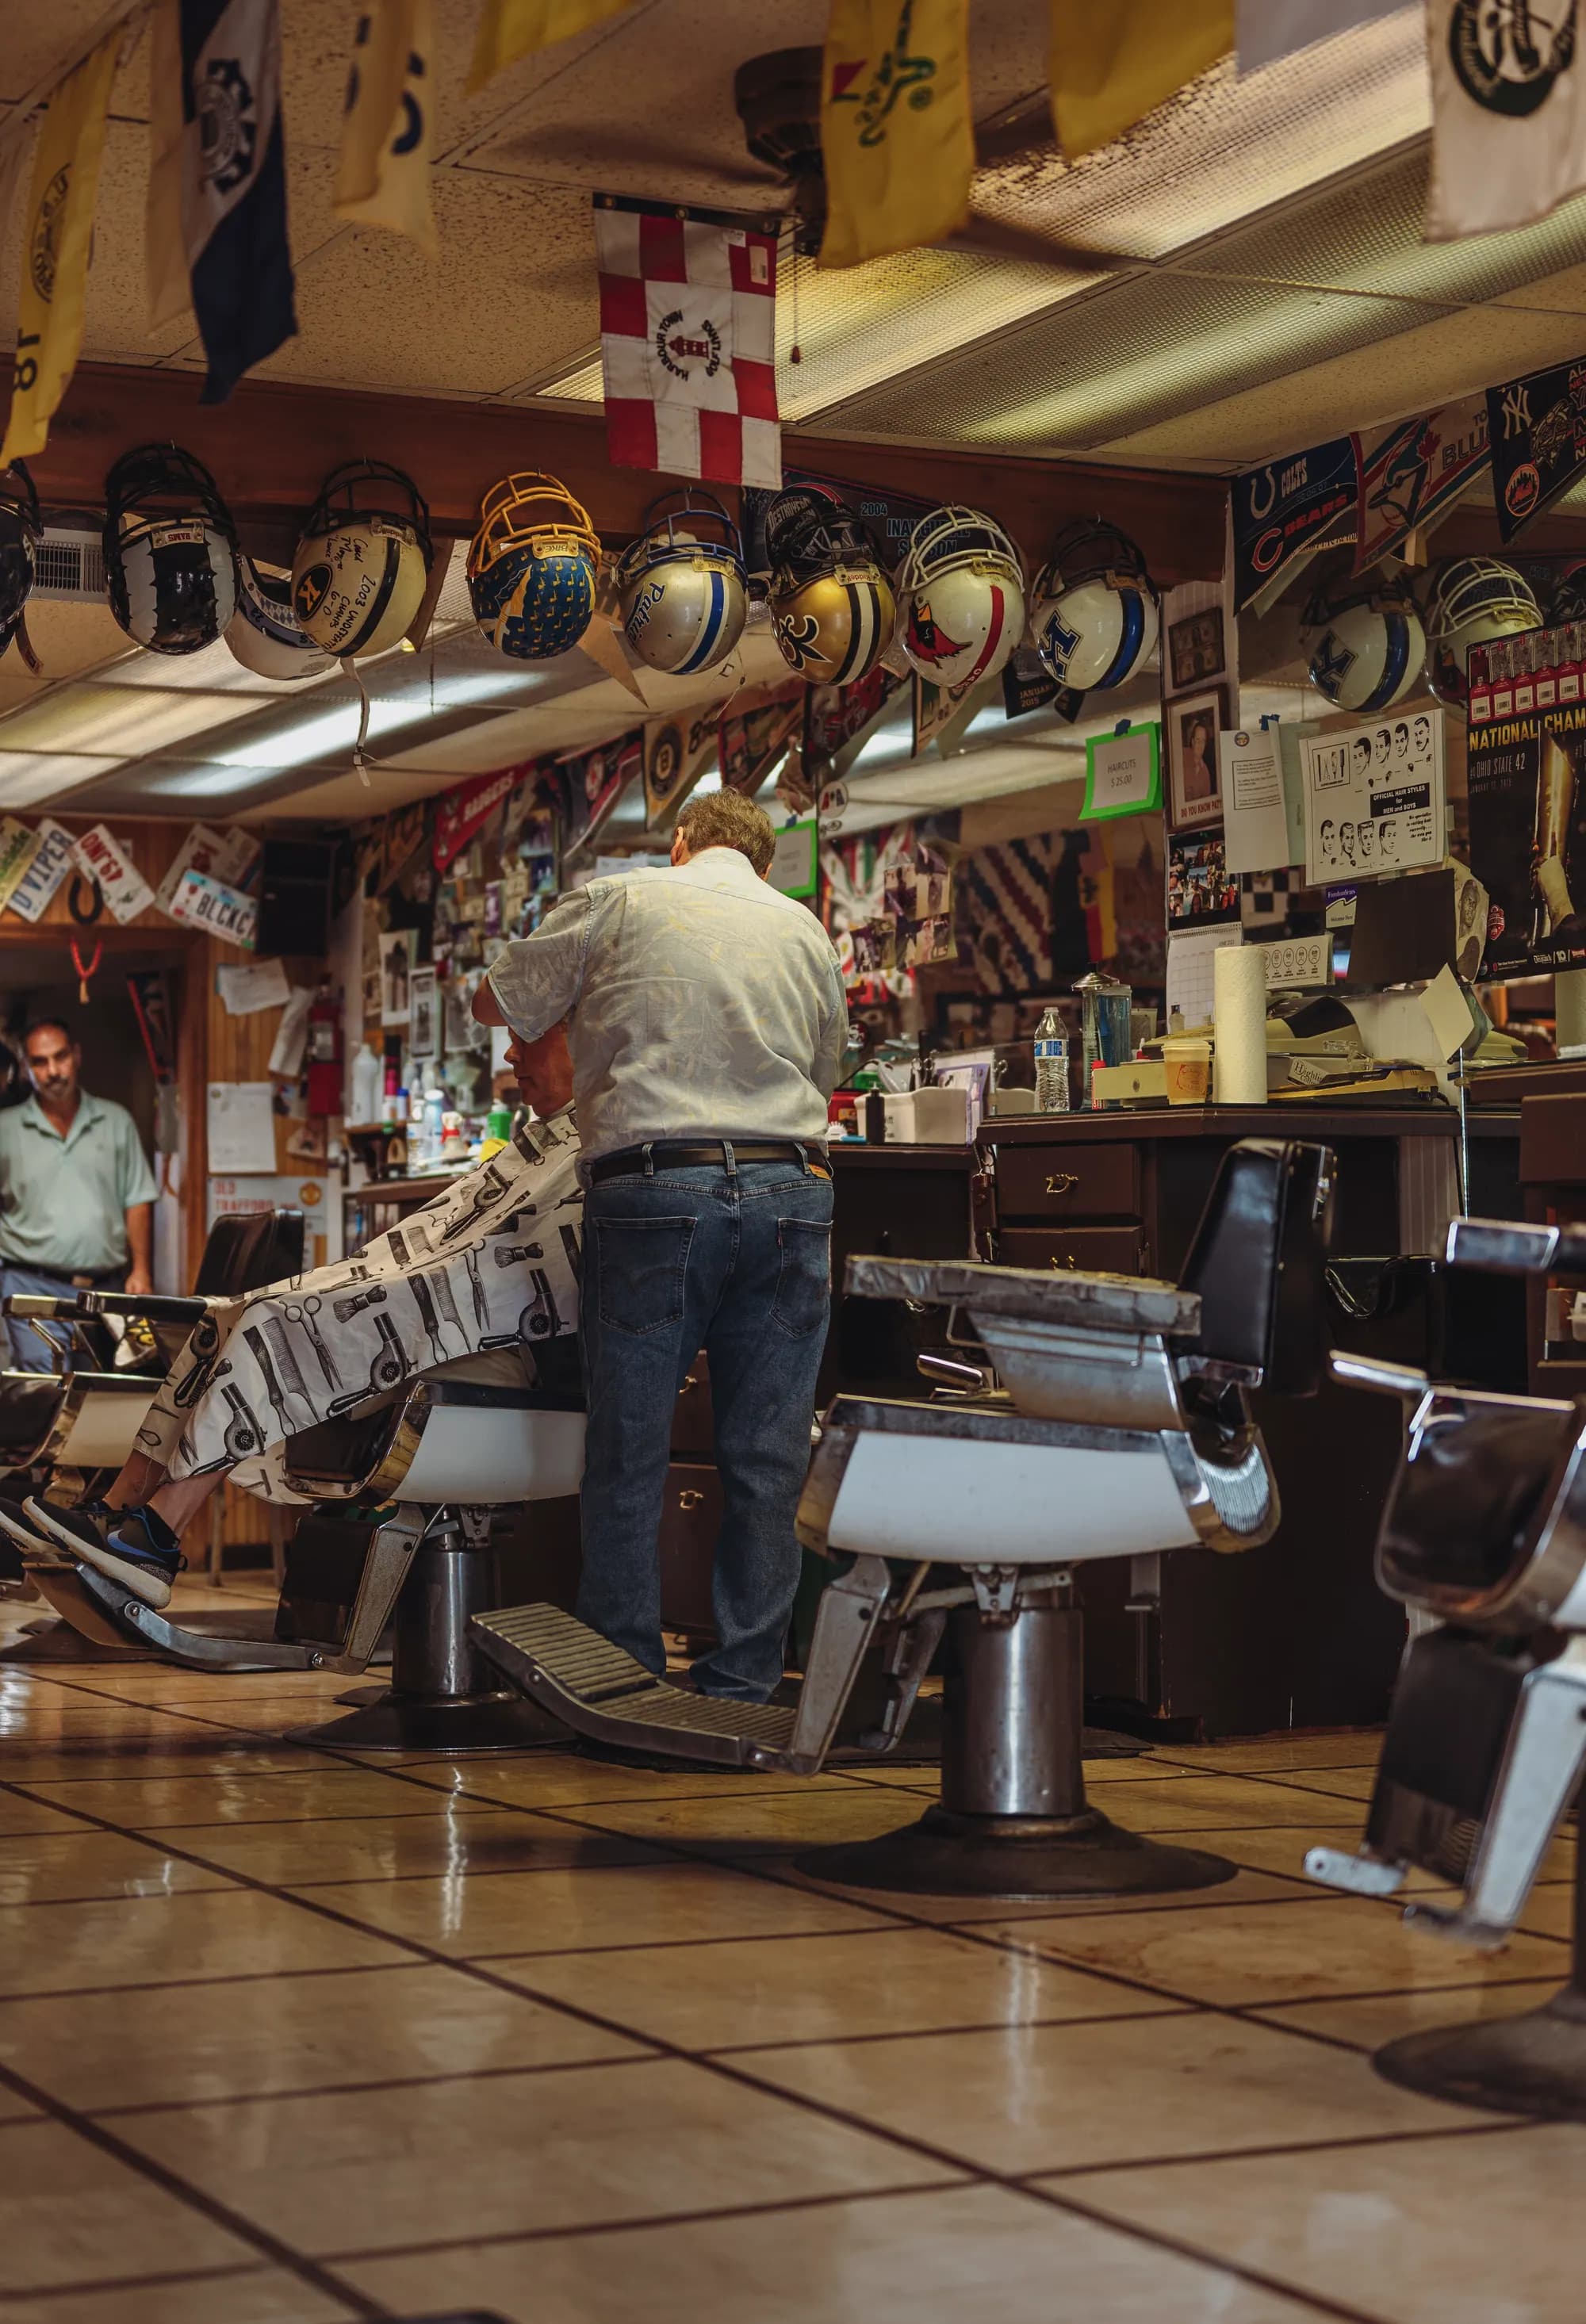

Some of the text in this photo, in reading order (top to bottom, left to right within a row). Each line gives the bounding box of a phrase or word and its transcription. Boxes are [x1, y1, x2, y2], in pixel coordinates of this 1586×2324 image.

[656, 332, 689, 381] HARBOUR
[1442, 426, 1492, 471] BLU
[860, 502, 888, 516] 2004
[1283, 493, 1348, 538] BEARS
[167, 532, 191, 542] RAMS
[354, 573, 377, 607] 2003
[1469, 718, 1539, 752] NATIONAL
[1107, 758, 1137, 774] HAIRCUTS
[1477, 760, 1492, 779] OHIO
[1493, 755, 1513, 775] STATE
[1515, 752, 1526, 771] 42
[1115, 774, 1132, 787] 25.00
[1373, 792, 1394, 801] OFFICIAL
[1407, 785, 1426, 794] STYLES
[1181, 807, 1188, 818] DO
[1188, 805, 1197, 816] YOU
[1197, 802, 1211, 814] KNOW
[1403, 802, 1416, 810] BOYS
